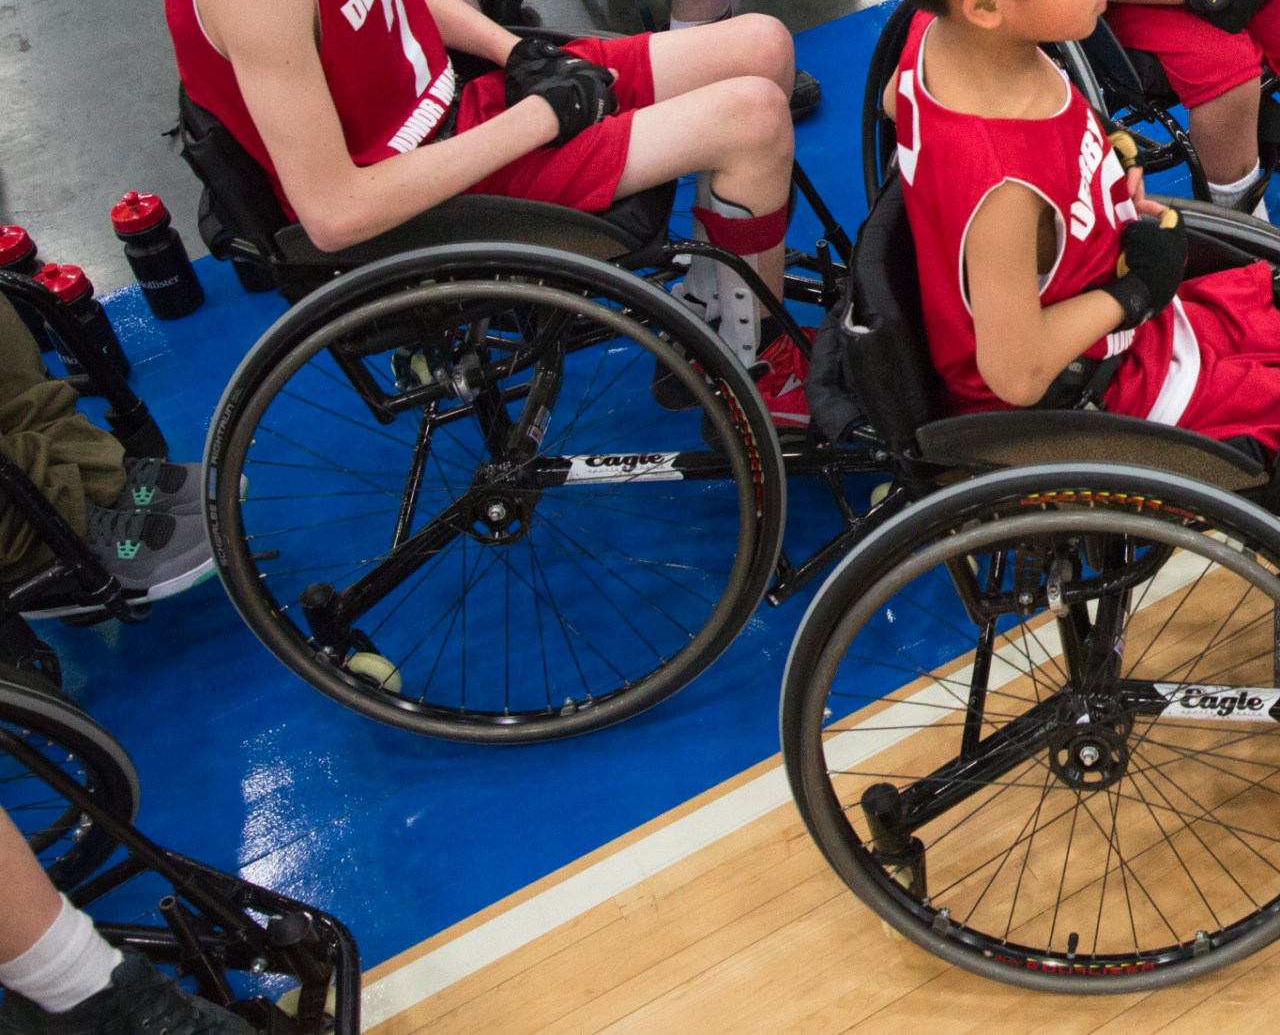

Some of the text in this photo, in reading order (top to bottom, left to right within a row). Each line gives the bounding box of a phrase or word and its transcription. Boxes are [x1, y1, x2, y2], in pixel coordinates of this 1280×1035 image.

[387, 98, 446, 154] JUNIOR
[138, 275, 179, 289] ollister
[1180, 688, 1265, 716] Eagle
